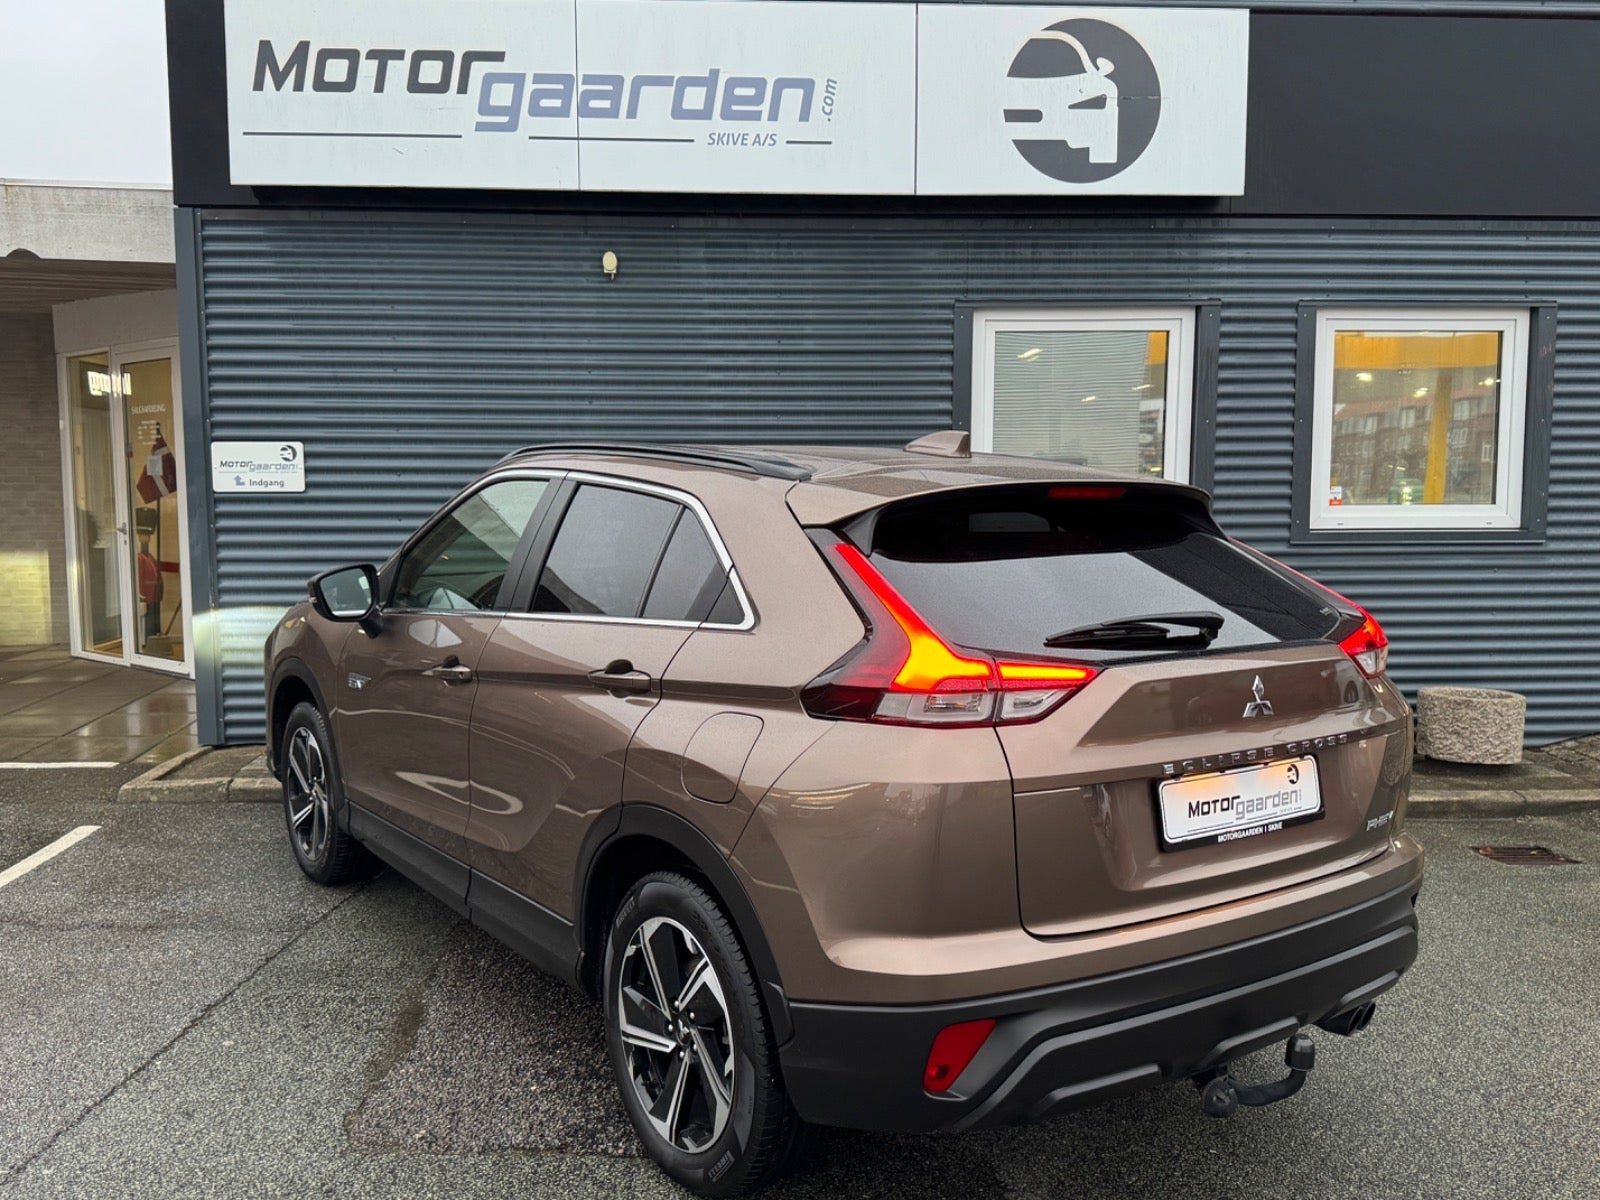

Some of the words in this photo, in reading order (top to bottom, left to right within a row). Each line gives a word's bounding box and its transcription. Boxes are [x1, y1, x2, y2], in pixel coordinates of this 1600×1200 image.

[707, 132, 749, 147] SKIVE
[752, 133, 777, 147] A/S
[249, 479, 285, 487] Indgang
[1217, 827, 1263, 843] MOTORGAARDEN
[1268, 821, 1283, 831] SKIVE
